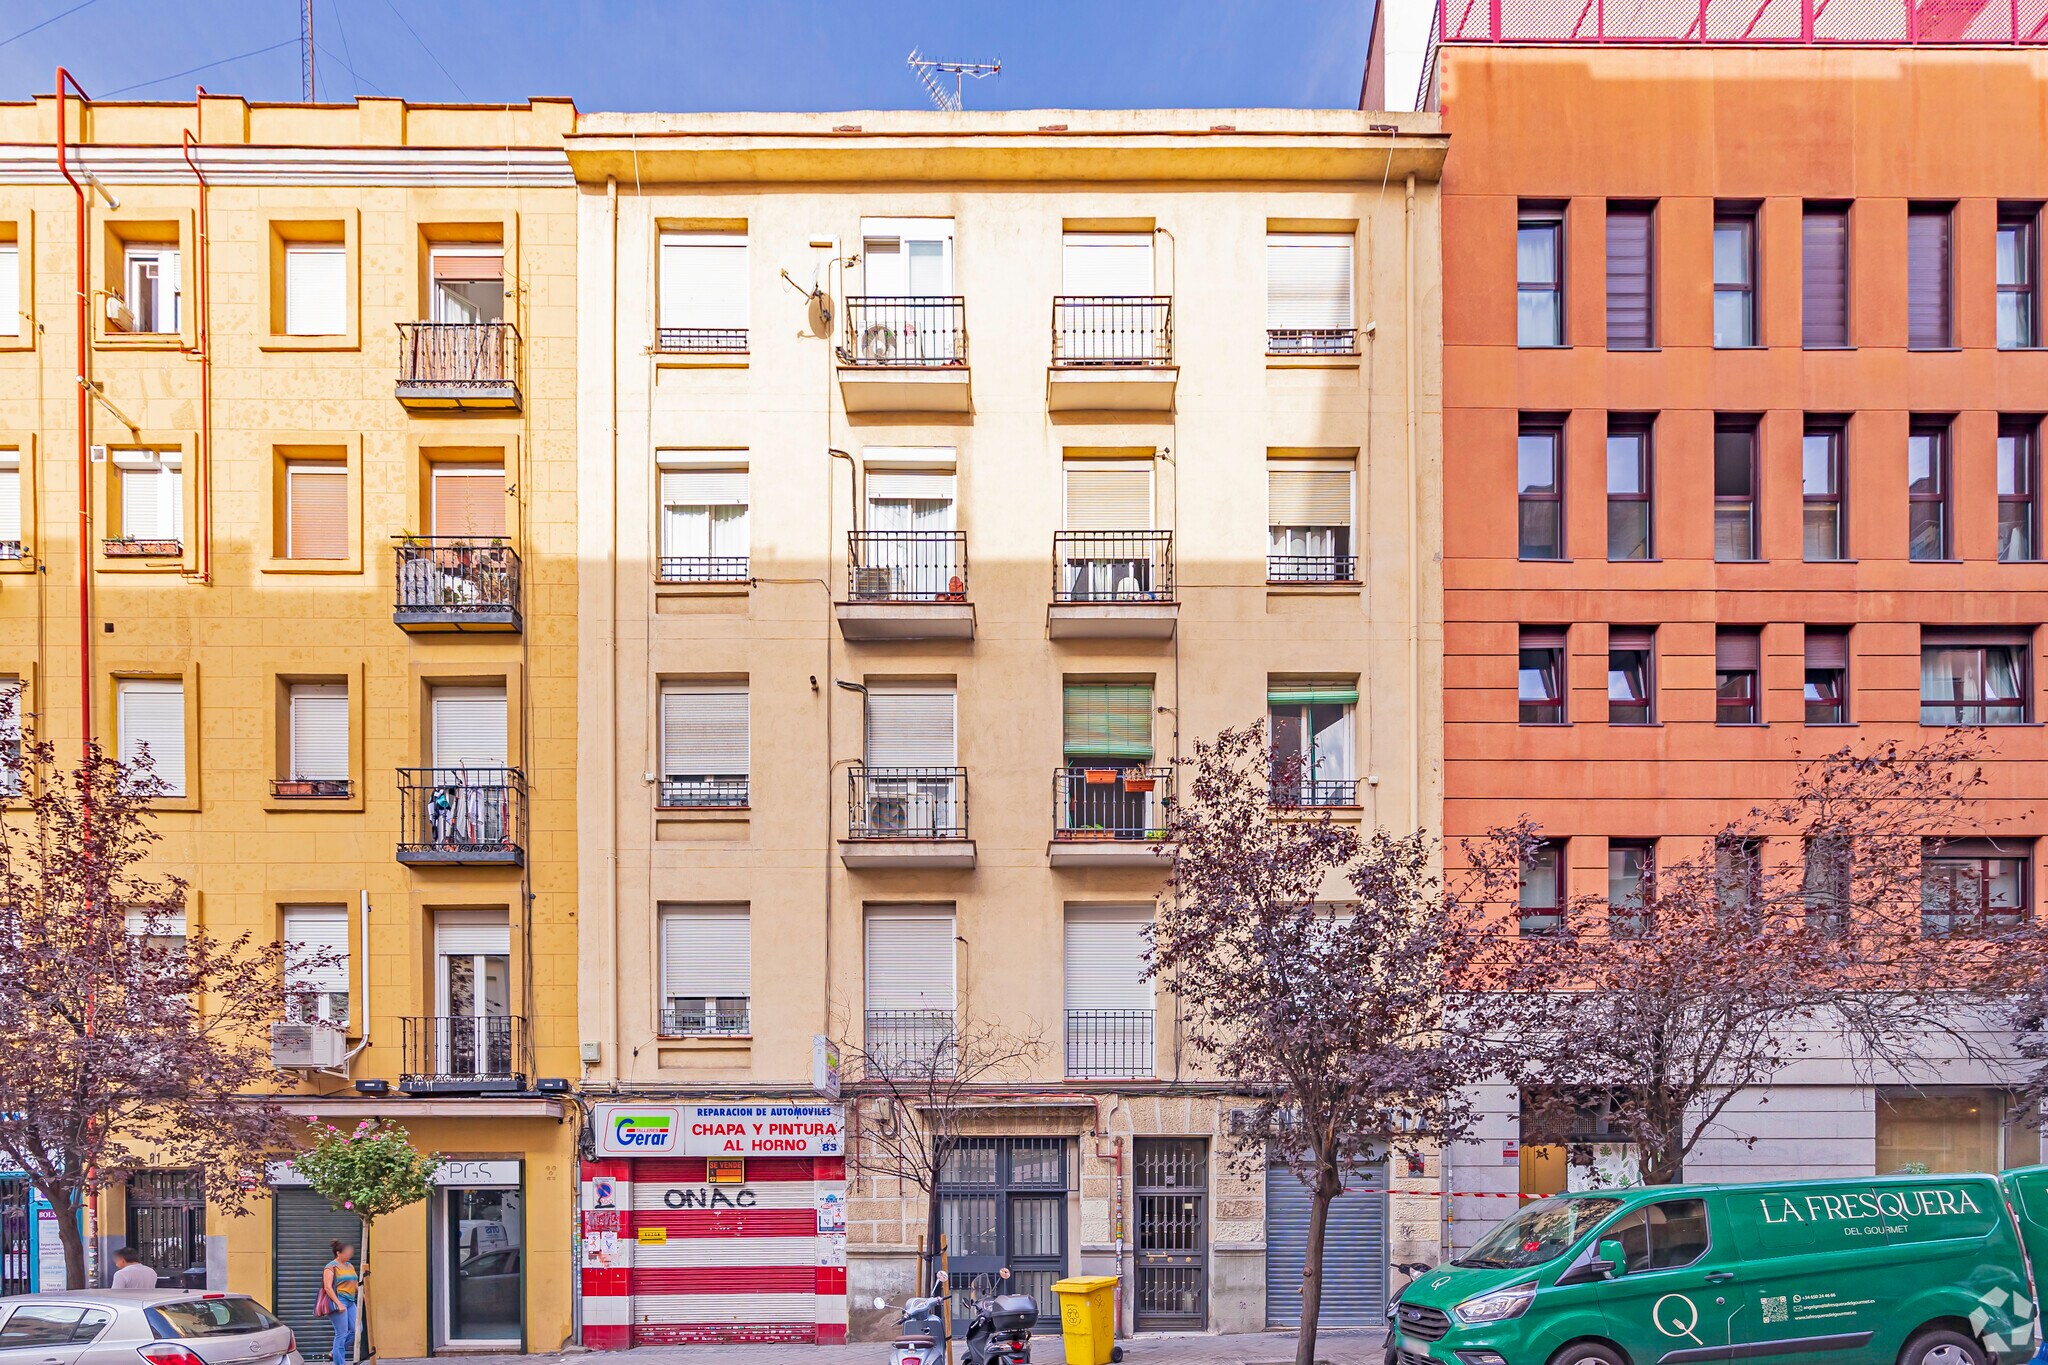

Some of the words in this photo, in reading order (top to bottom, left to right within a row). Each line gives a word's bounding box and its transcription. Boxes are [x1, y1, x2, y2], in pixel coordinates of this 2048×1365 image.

[697, 1107, 753, 1117] REPARACION
[756, 1107, 767, 1116] DE
[616, 1118, 668, 1146] Gerar
[691, 1123, 746, 1136] CHAPA
[753, 1123, 764, 1136] Y
[769, 1123, 837, 1136] PINTURA
[723, 1139, 744, 1151] AL
[751, 1139, 807, 1151] HORNO
[822, 1143, 837, 1152] 83
[149, 1152, 161, 1164] 81
[709, 1161, 718, 1169] SE
[719, 1161, 742, 1169] VENDE
[1760, 1197, 1805, 1224] LA
[1804, 1189, 1981, 1222] FRESQUERA
[1844, 1226, 1863, 1236] DEL
[1864, 1224, 1909, 1236] GOURMET
